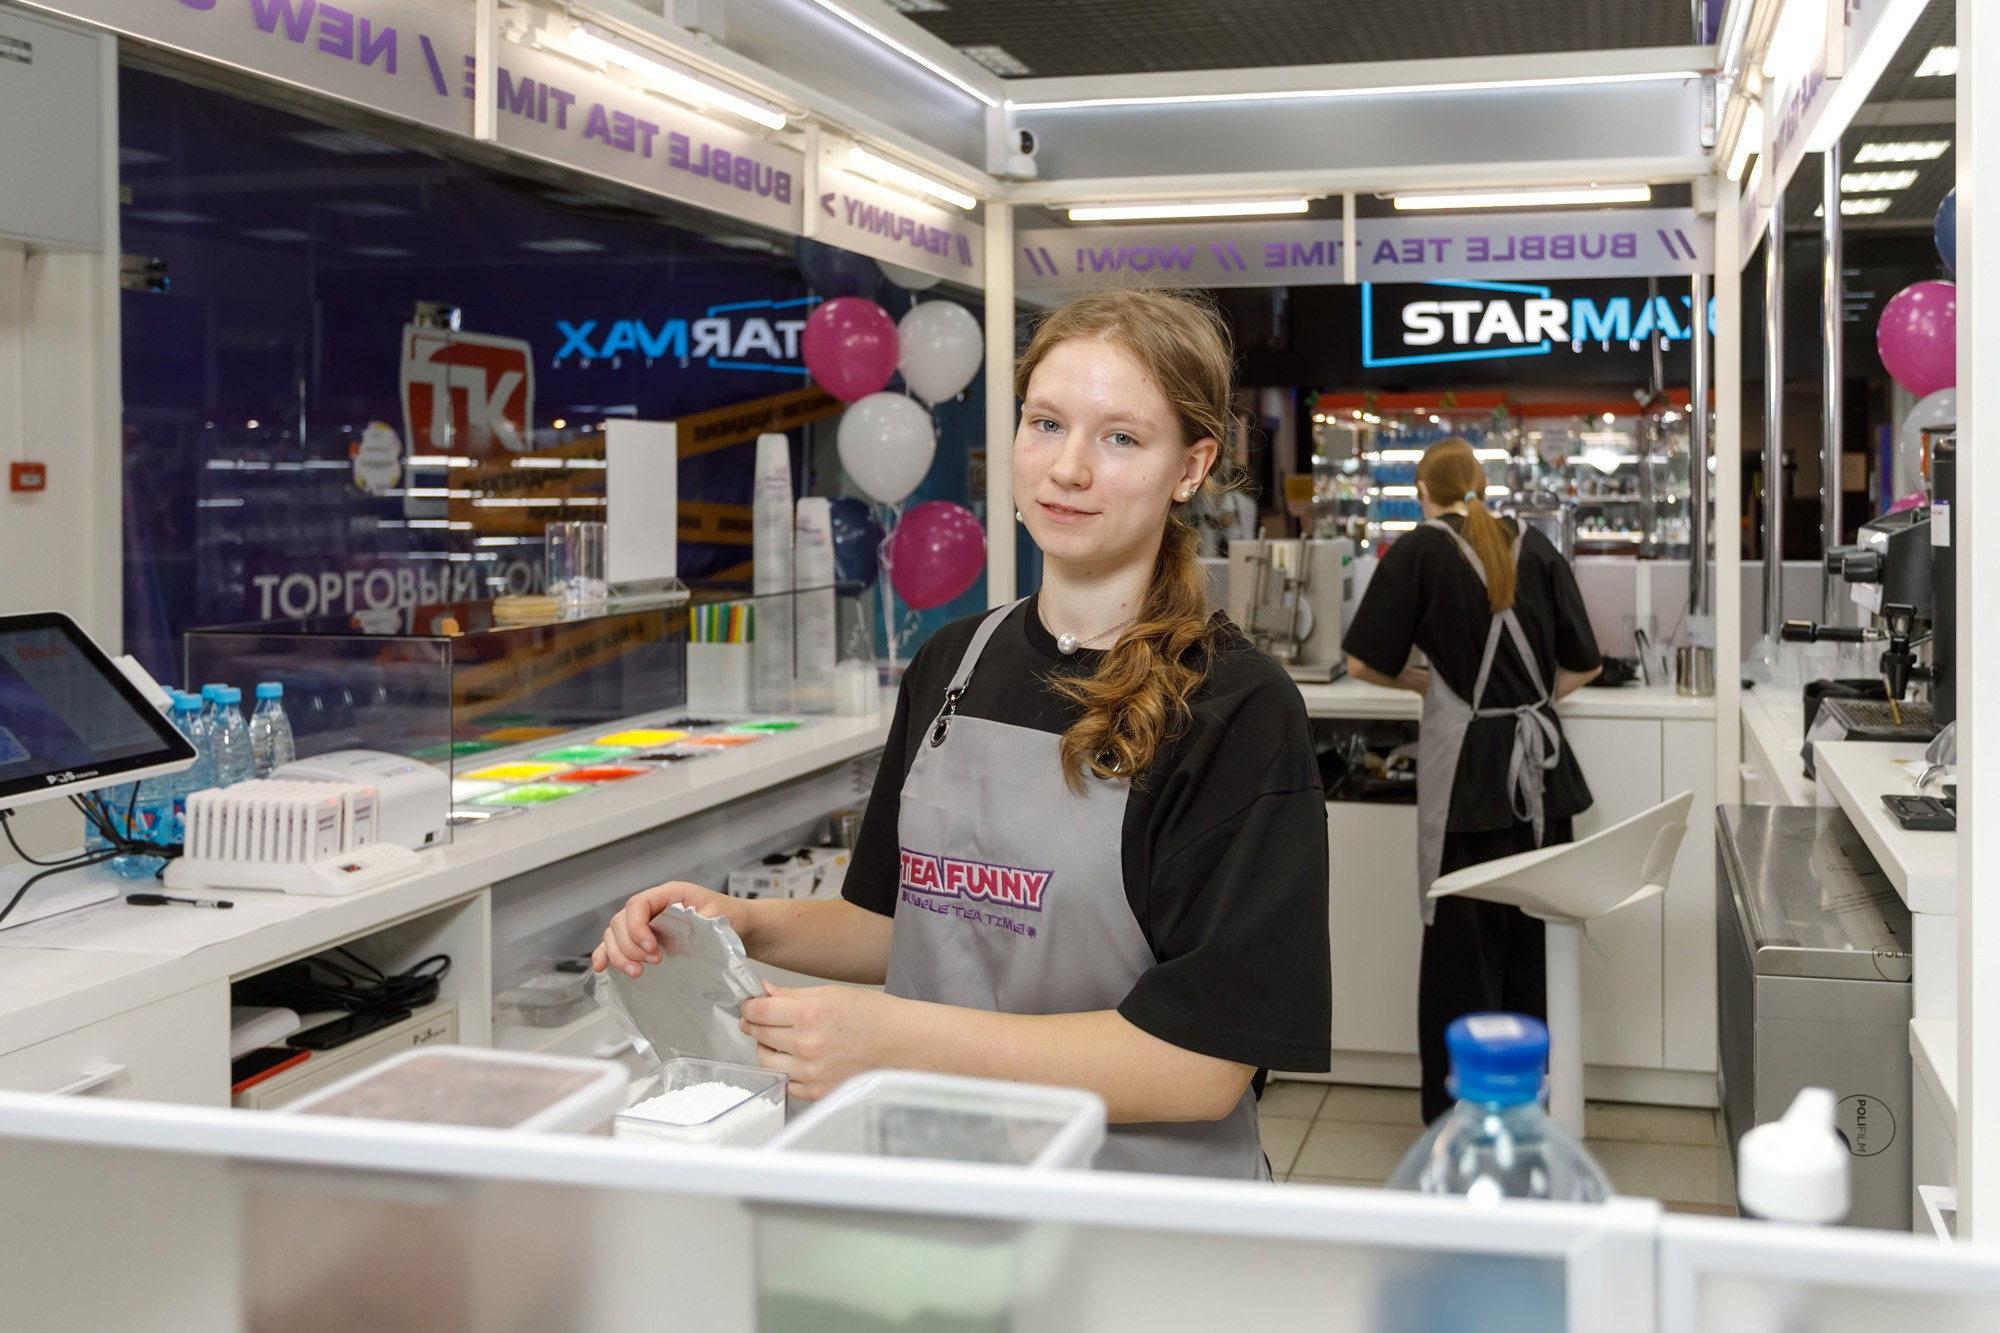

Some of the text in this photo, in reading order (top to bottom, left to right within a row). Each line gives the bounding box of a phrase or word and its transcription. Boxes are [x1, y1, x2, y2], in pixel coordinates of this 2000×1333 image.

[901, 889, 950, 915] BUBBLE
[952, 904, 983, 923] TEA
[945, 860, 1047, 906] FUNNY
[1856, 1099, 1867, 1153] POLIFILM
